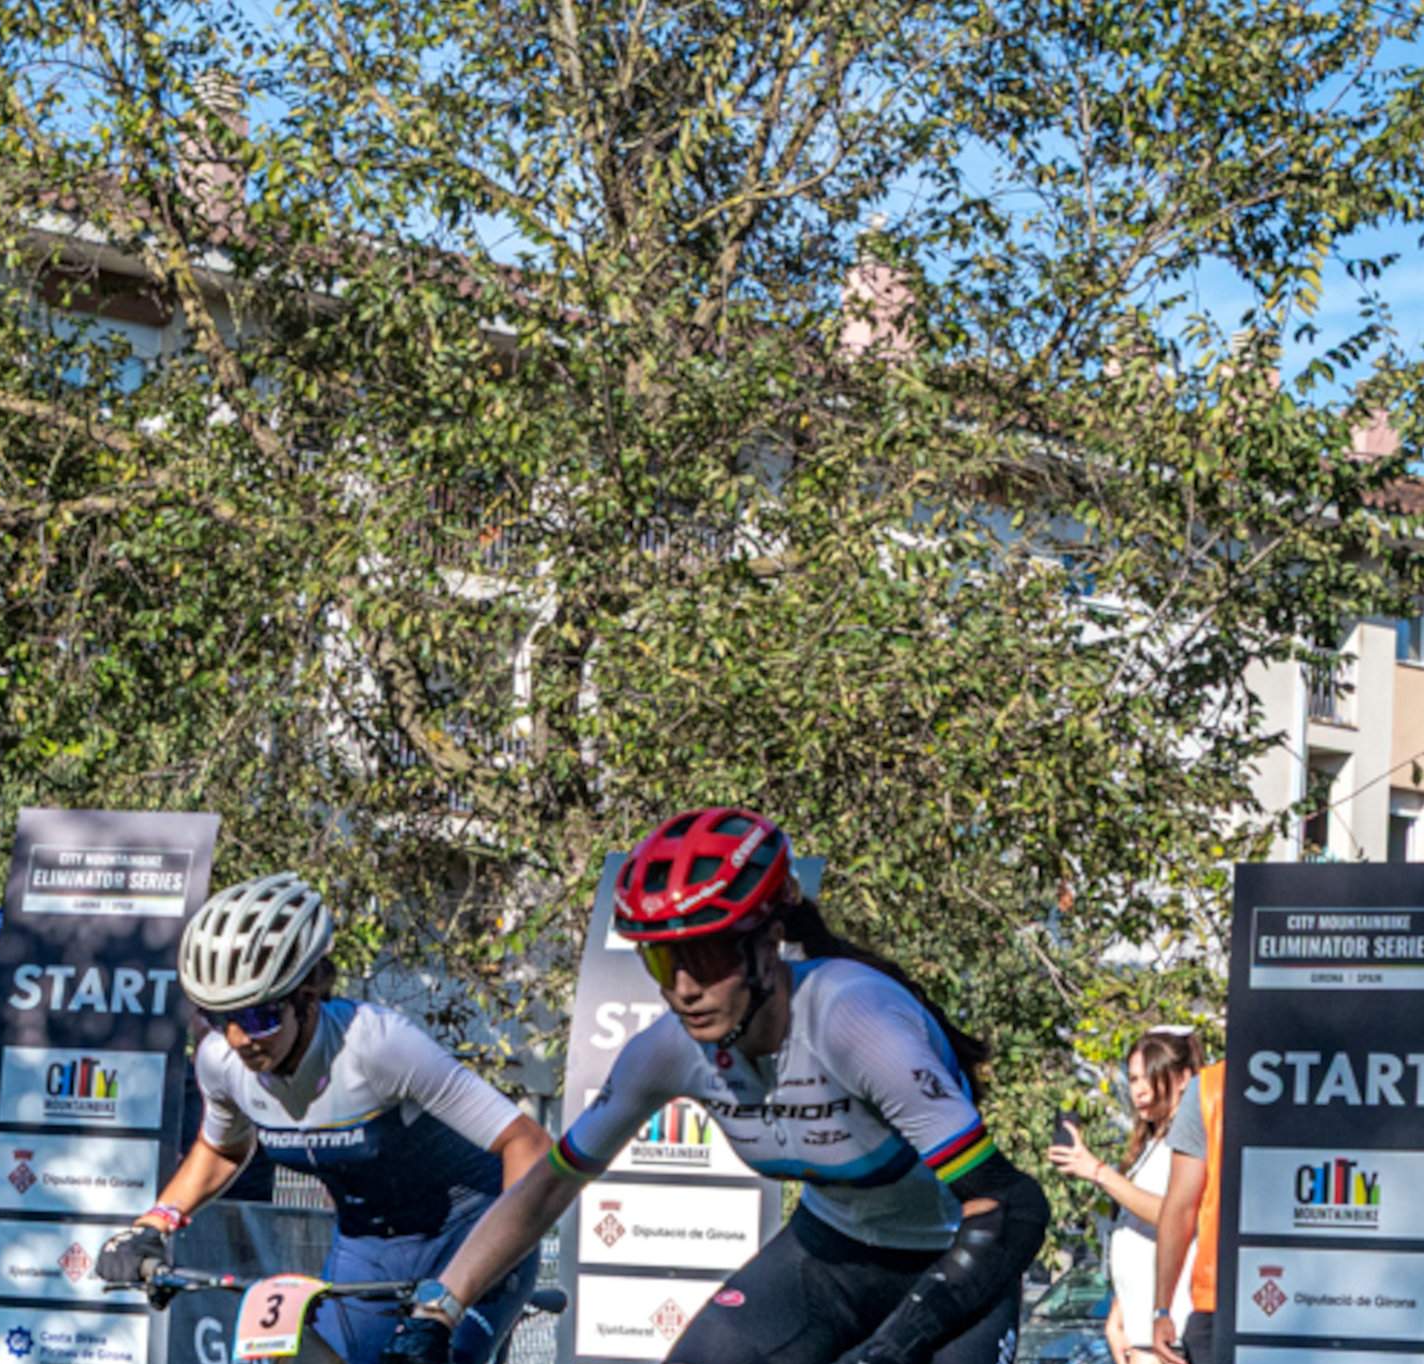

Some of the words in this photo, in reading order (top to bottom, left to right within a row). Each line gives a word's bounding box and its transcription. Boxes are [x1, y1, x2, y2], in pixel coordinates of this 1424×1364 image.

[33, 870, 125, 889] ELIMINATOR
[129, 871, 183, 891] SERIES
[1287, 915, 1315, 931] CITY
[1259, 935, 1369, 958] ELIMINATOR
[8, 963, 177, 1016] START
[46, 1056, 119, 1099] CITY
[704, 1098, 850, 1121] MERIDA
[631, 1145, 711, 1160] MOUNTAINBIKE
[1295, 1157, 1380, 1205] CITY
[1294, 1207, 1379, 1222] MOUNTAINBIKE
[632, 1224, 687, 1240] Diputació
[689, 1226, 704, 1239] de
[706, 1227, 746, 1241] Girona
[259, 1293, 285, 1328] 3
[1294, 1292, 1352, 1308] Diputació
[1355, 1295, 1372, 1307] de
[1375, 1296, 1416, 1309] Girona
